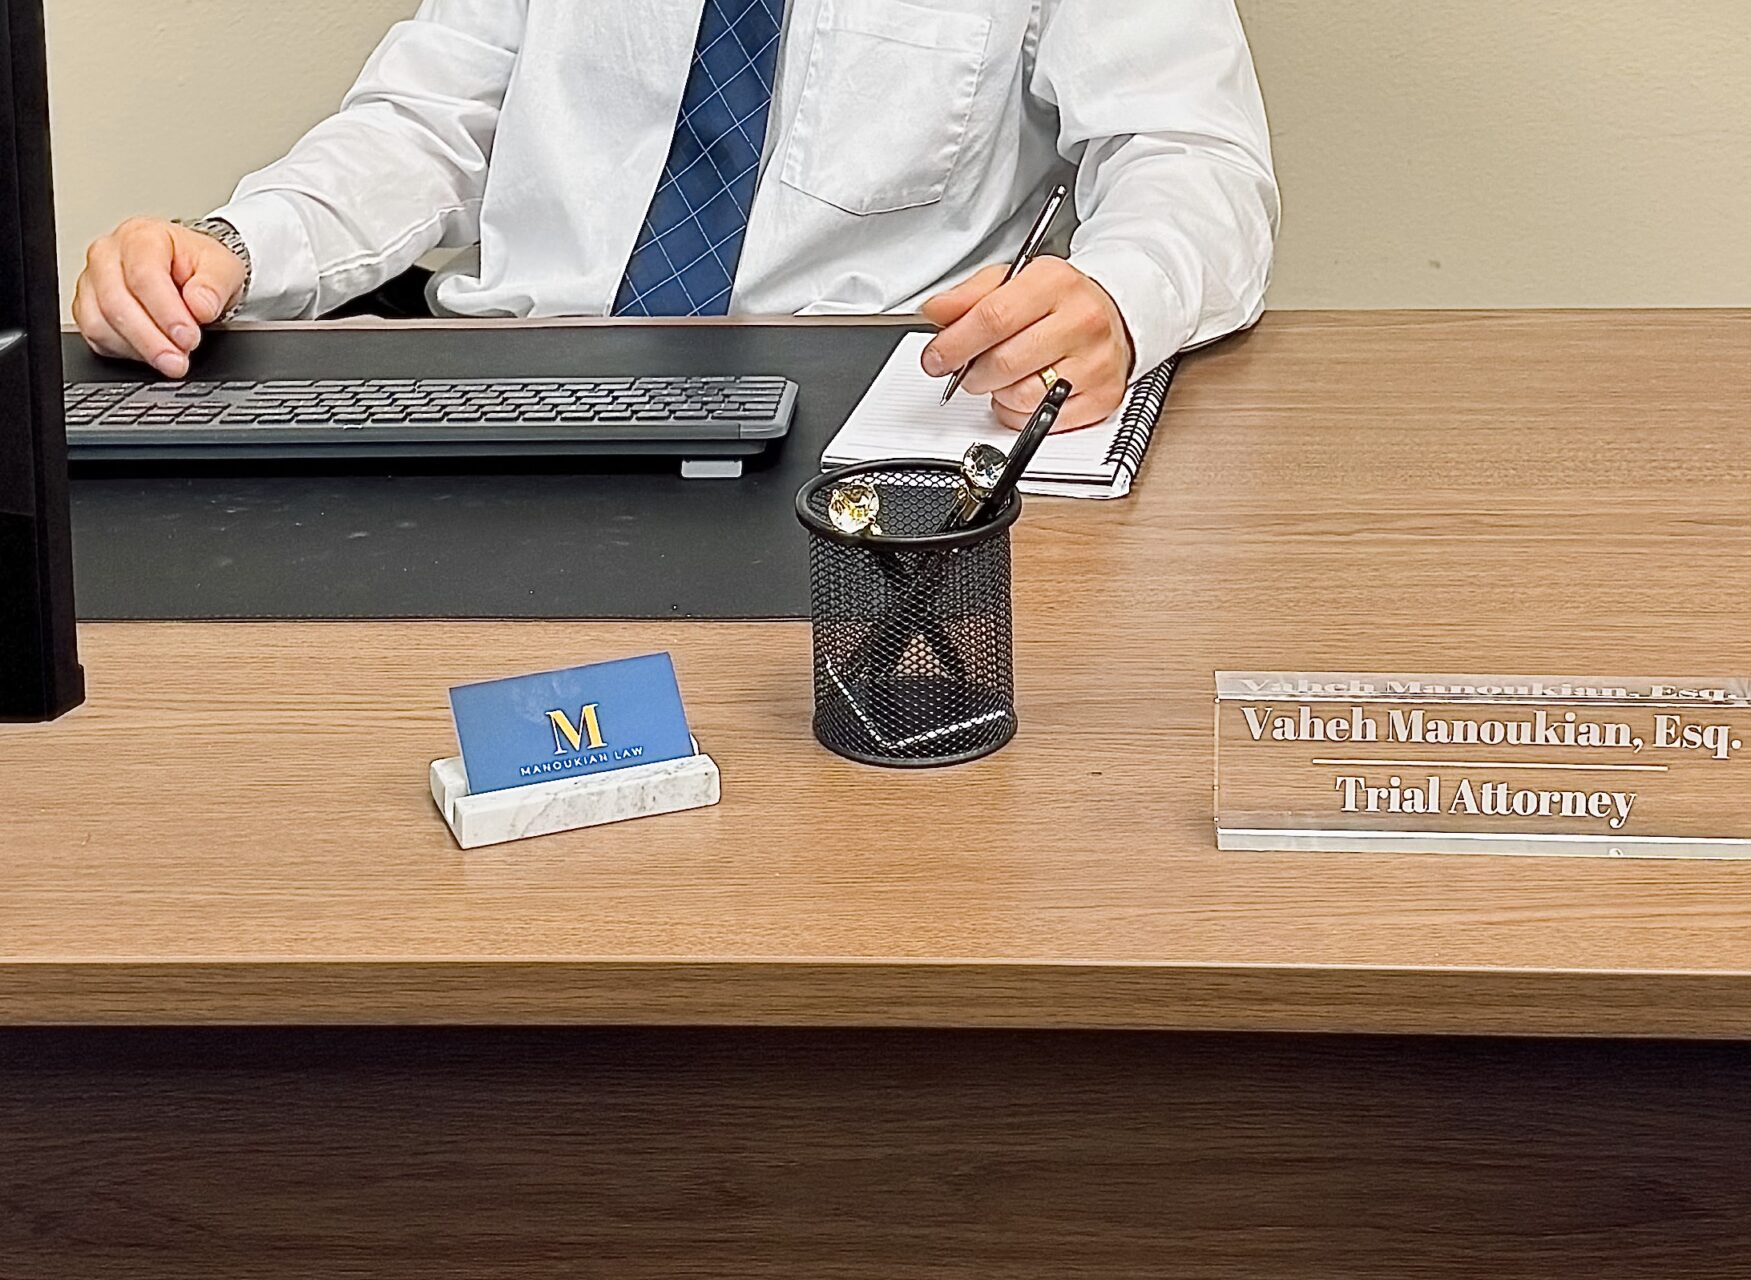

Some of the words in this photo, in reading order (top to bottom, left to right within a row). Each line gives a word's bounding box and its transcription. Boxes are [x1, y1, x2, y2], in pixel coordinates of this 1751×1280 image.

[545, 703, 608, 755] M
[1240, 706, 1379, 742] Vaheh
[1386, 709, 1645, 754] Manoukian,
[1653, 714, 1742, 759] Esq.
[520, 752, 609, 777] MANOUKIAN
[614, 746, 644, 761] LAW
[1335, 776, 1441, 813] Trial
[1449, 778, 1637, 829] Attorney
